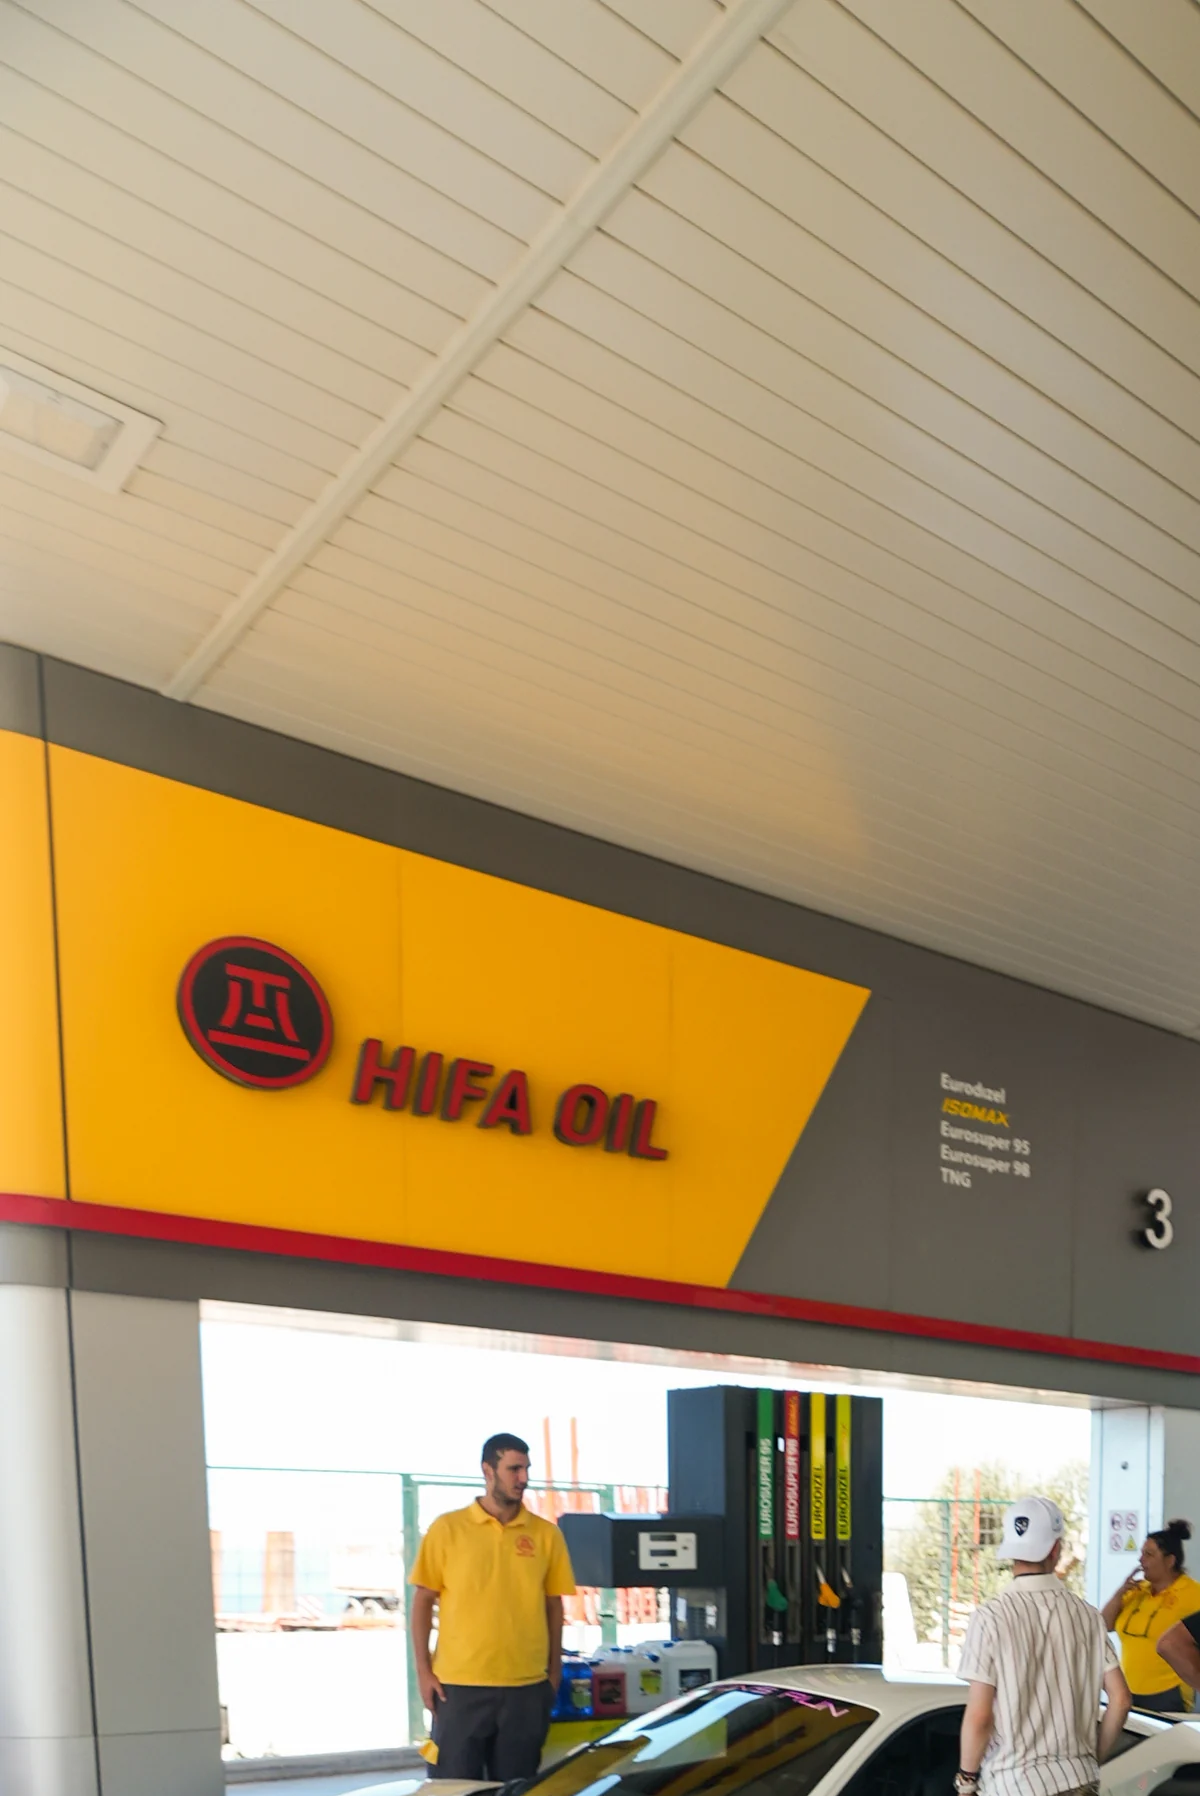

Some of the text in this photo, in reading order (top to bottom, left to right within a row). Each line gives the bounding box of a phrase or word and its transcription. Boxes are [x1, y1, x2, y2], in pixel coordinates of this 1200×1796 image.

[351, 1038, 670, 1161] HIFA OIL
[941, 1071, 1007, 1105] Eurodizel
[942, 1097, 1010, 1128] ISOMAX
[941, 1119, 1031, 1156] Eurosuper 95
[941, 1143, 1031, 1178] Eurosuper 98
[940, 1165, 972, 1189] TNG
[1145, 1188, 1174, 1250] 3
[759, 1455, 773, 1536] EUROSUPER
[785, 1456, 800, 1536] EUROSUPER
[813, 1464, 824, 1536] EURODIZEL
[838, 1466, 849, 1536] EURODIZEL
